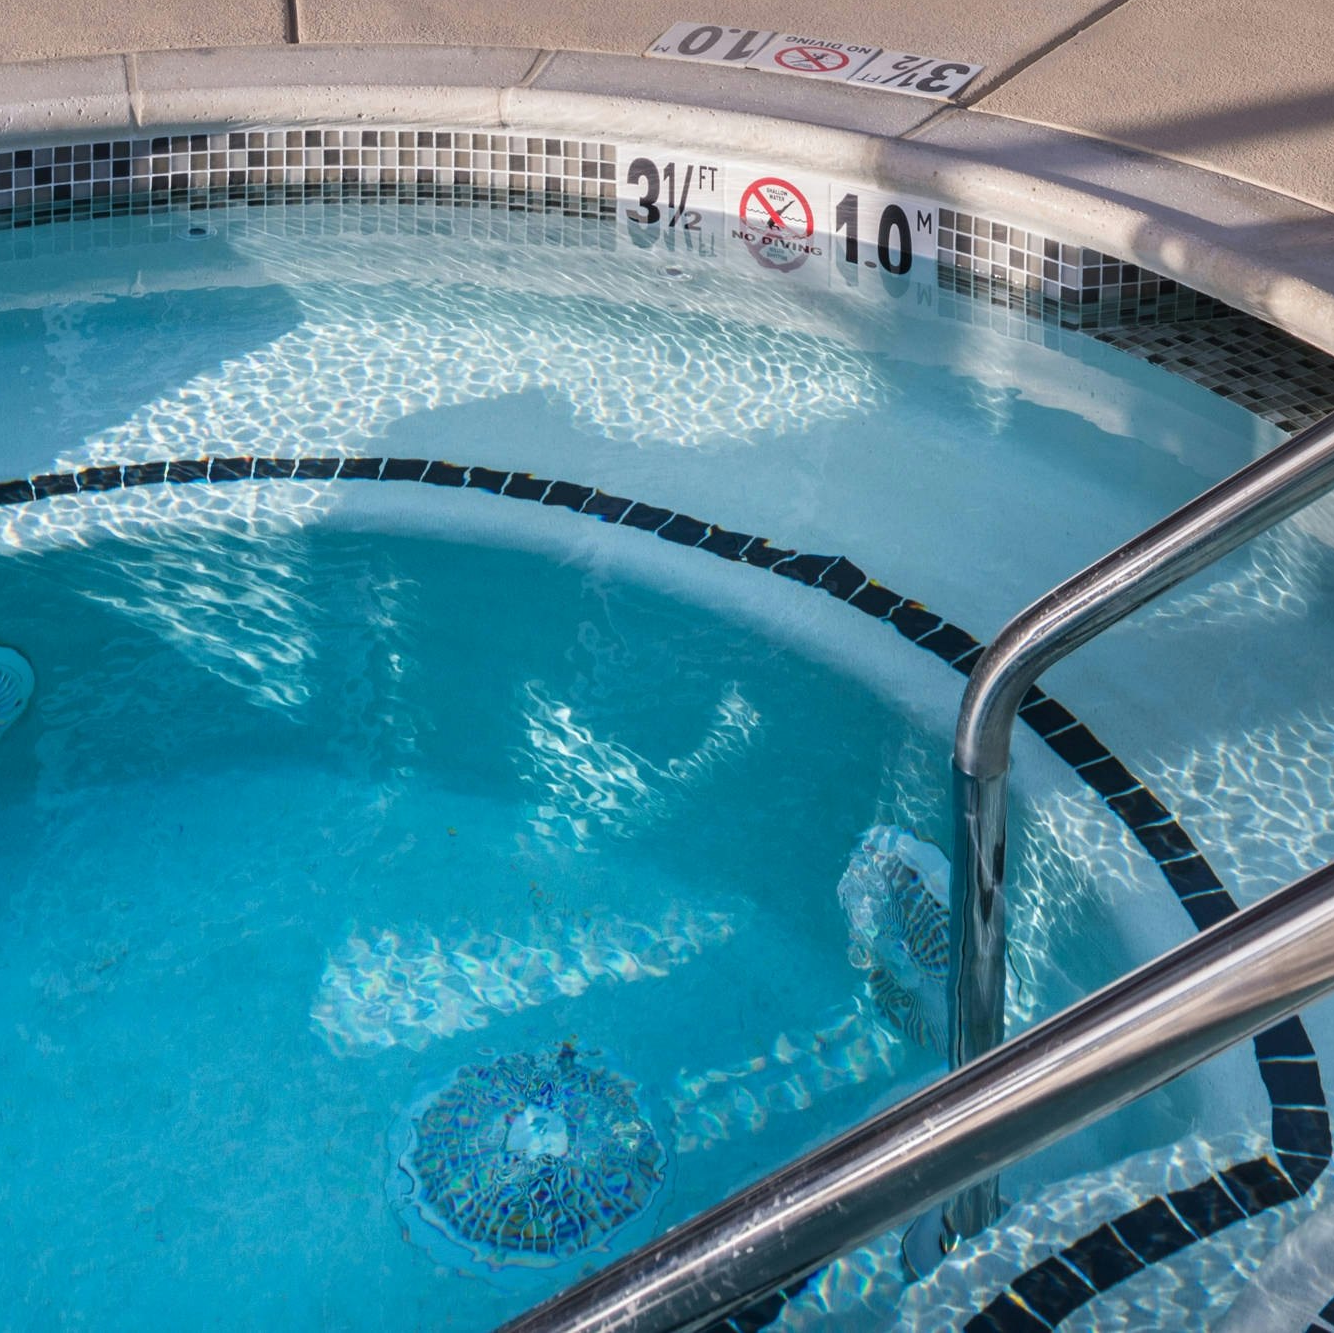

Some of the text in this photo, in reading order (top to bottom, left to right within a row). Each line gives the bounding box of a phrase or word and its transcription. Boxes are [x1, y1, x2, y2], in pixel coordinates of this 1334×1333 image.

[653, 25, 759, 60] 1.0 M
[785, 36, 872, 54] NO DIVING
[857, 73, 881, 83] FT
[699, 165, 718, 191] FT
[766, 187, 788, 197] SHALLOW
[769, 194, 785, 203] WATER
[732, 230, 823, 256] NO DIVING
[836, 193, 932, 275] 1.0 M
